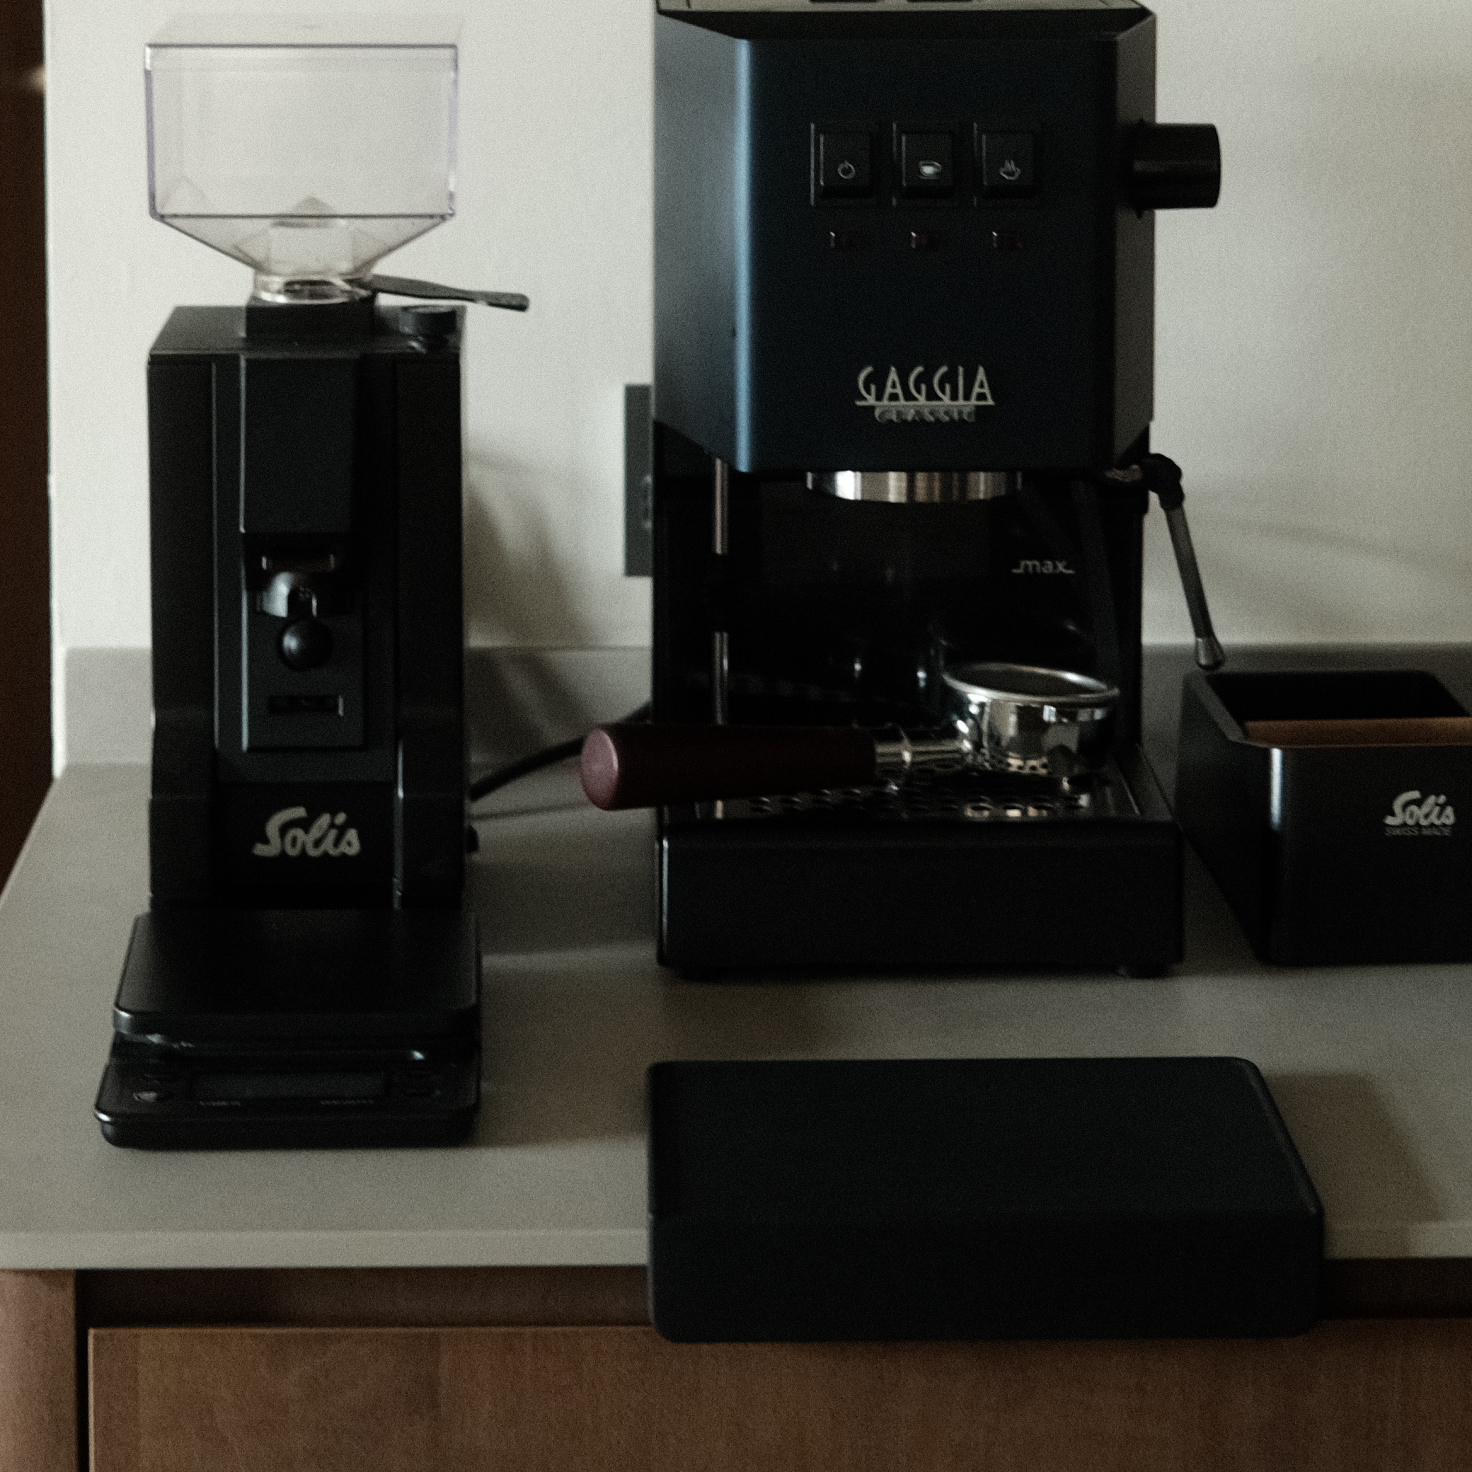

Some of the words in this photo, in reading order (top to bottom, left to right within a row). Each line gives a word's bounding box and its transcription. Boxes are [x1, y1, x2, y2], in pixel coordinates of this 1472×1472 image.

[855, 365, 995, 405] GAGGIA
[1382, 789, 1457, 826] Solis
[251, 805, 362, 858] Solis
